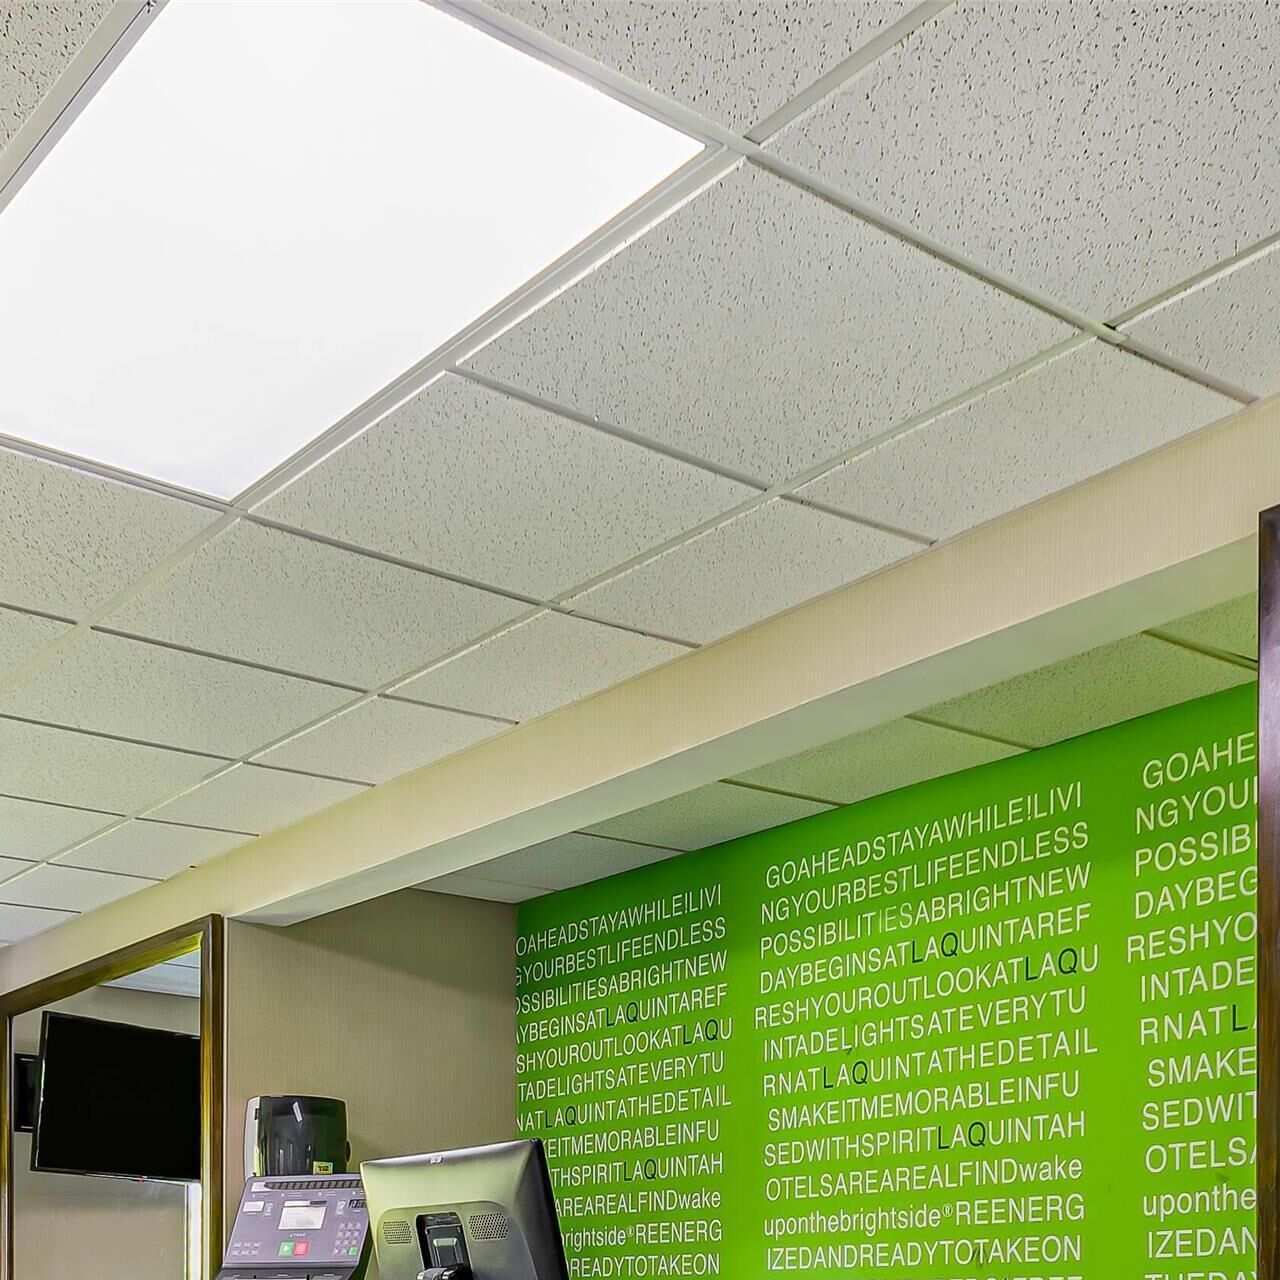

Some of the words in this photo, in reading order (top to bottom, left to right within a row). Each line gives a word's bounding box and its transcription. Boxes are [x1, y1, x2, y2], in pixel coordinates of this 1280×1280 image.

[766, 781, 1082, 888] GOAHEADSTAYAWHILE!LIVI
[1135, 775, 1257, 834] NGYOU
[761, 821, 1089, 925] NGYOURBESTLIFEENDLESS
[760, 862, 1091, 960] POSSIBILITIESABRIGHTNEW
[760, 902, 1091, 994] DAYBEGINSATLAQUINTAREF
[516, 984, 728, 1044] YBEGINSATLAQUINTAREF
[754, 944, 1099, 1030] RESHYOUROUTLOOKATLAQU
[763, 985, 1086, 1062] INTADELIGHTSATEVERYTU
[1140, 1004, 1256, 1046] RNATL
[763, 1027, 1098, 1097] RNATLAQUINTATHEDETAIL
[768, 1070, 1079, 1132] SMAKEITMEMORABLEINFU
[764, 1110, 1086, 1166] SEDWITHSPIRITLAQUINTAH
[1145, 1136, 1256, 1173] OTELS
[766, 1154, 1082, 1201] OTELSAREAREALFINDwake
[566, 1253, 720, 1278] READYTOTAKEON
[767, 1234, 1081, 1270] IZEDANDREADYTOTAKEON
